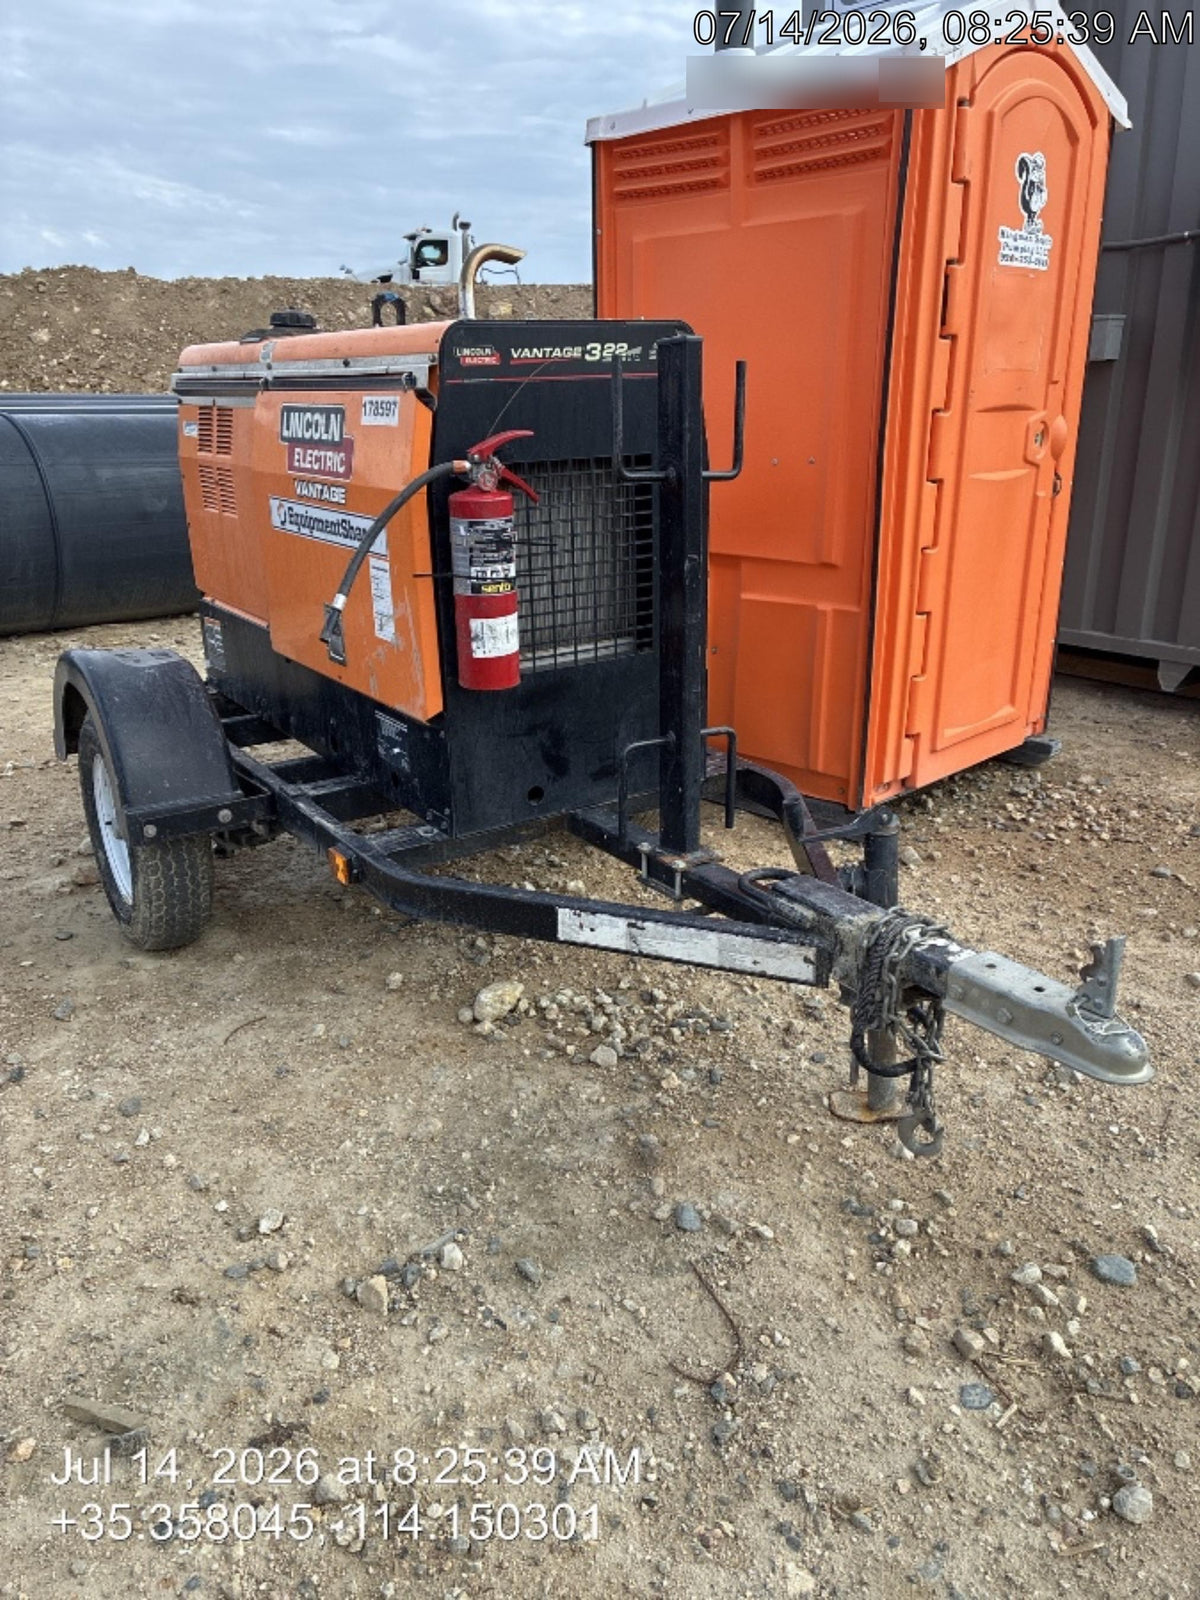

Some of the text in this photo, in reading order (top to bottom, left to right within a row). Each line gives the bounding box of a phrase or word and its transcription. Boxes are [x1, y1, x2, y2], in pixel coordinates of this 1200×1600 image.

[511, 347, 582, 359] VANTAGE
[585, 342, 628, 361] 322
[363, 400, 397, 417] 178597
[282, 411, 341, 442] LINCOLN
[293, 447, 346, 473] ELECTRIC
[294, 480, 346, 504] VANTAGE
